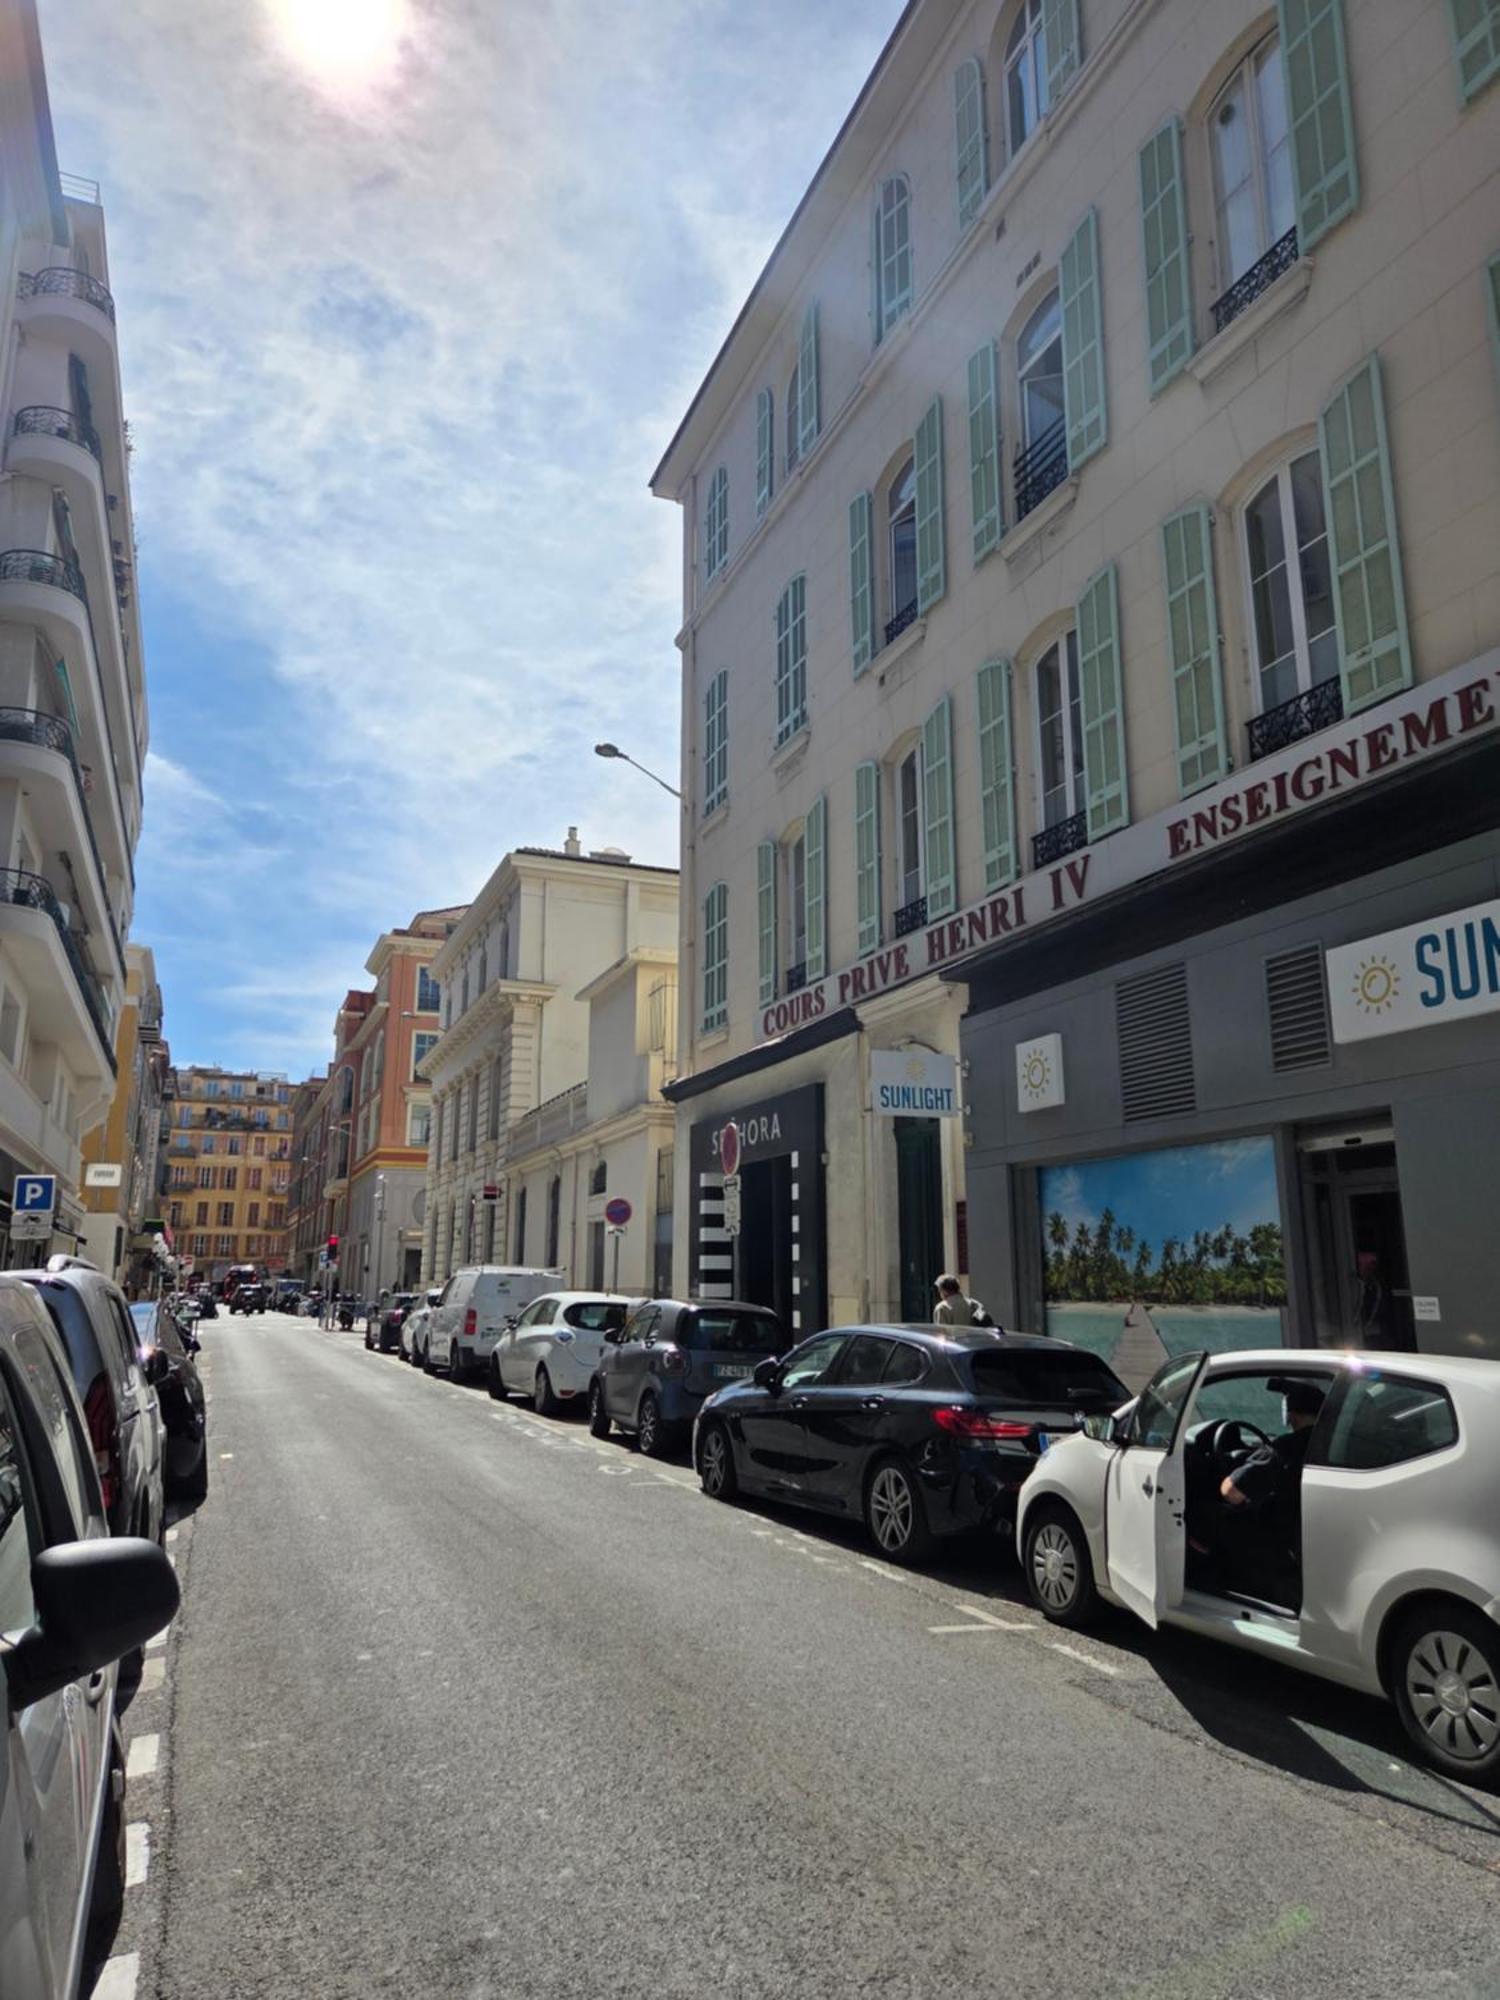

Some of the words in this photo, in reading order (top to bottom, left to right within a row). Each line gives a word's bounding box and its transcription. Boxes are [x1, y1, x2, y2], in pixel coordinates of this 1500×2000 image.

[763, 984, 825, 1036] COURS
[838, 943, 909, 1004] PRIVE
[926, 887, 1027, 966] HENRI
[1049, 854, 1091, 910] IV
[1166, 671, 1500, 859] ENSEIGNEME
[880, 1085, 952, 1111] SUNLIGHT
[711, 1112, 781, 1155] SHORA
[24, 1183, 43, 1205] P
